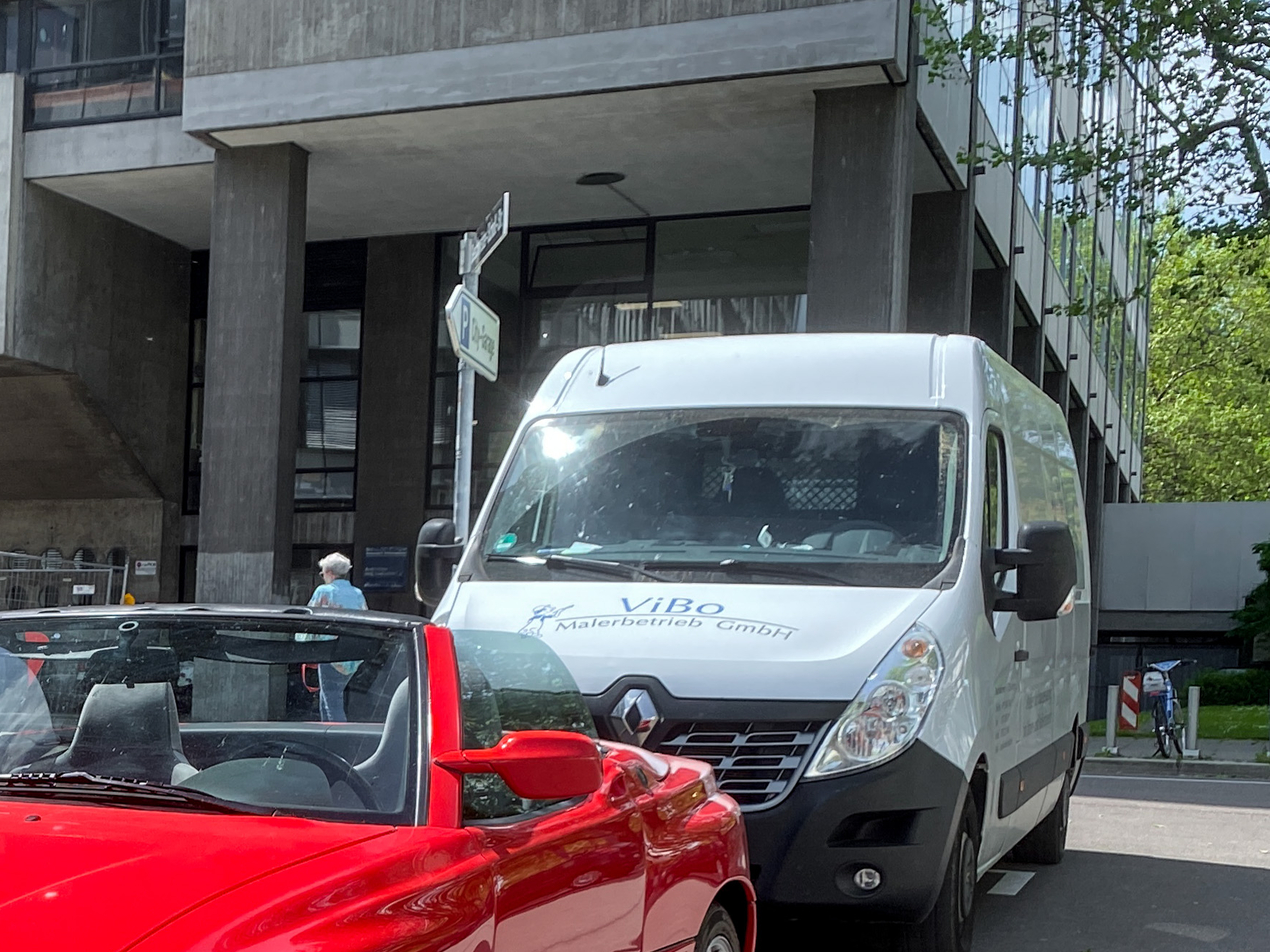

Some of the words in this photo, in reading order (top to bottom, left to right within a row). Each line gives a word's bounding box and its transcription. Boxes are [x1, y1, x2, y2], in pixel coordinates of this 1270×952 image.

[621, 597, 725, 614] ViBo
[555, 617, 702, 632] Malerbetrieb
[716, 620, 793, 640] GmbH
